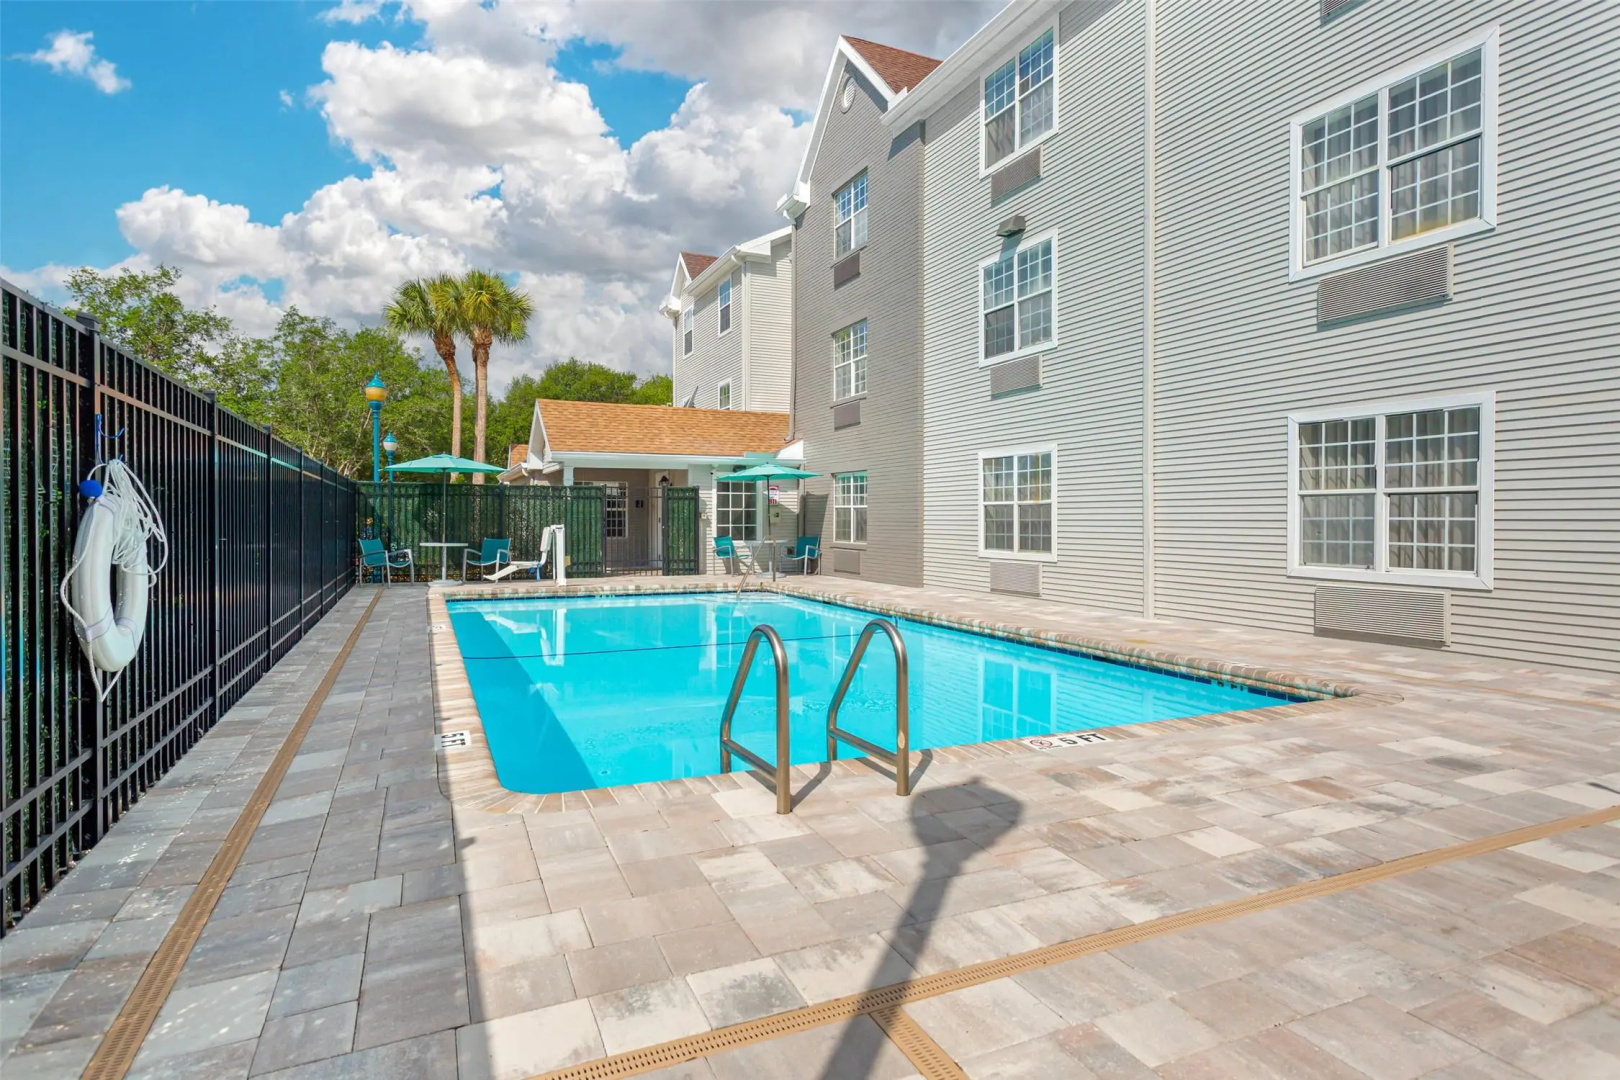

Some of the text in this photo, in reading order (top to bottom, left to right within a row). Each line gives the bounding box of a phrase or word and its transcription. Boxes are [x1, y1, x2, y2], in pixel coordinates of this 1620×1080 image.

[441, 738, 466, 748] FT
[1057, 733, 1107, 745] 5 FT
